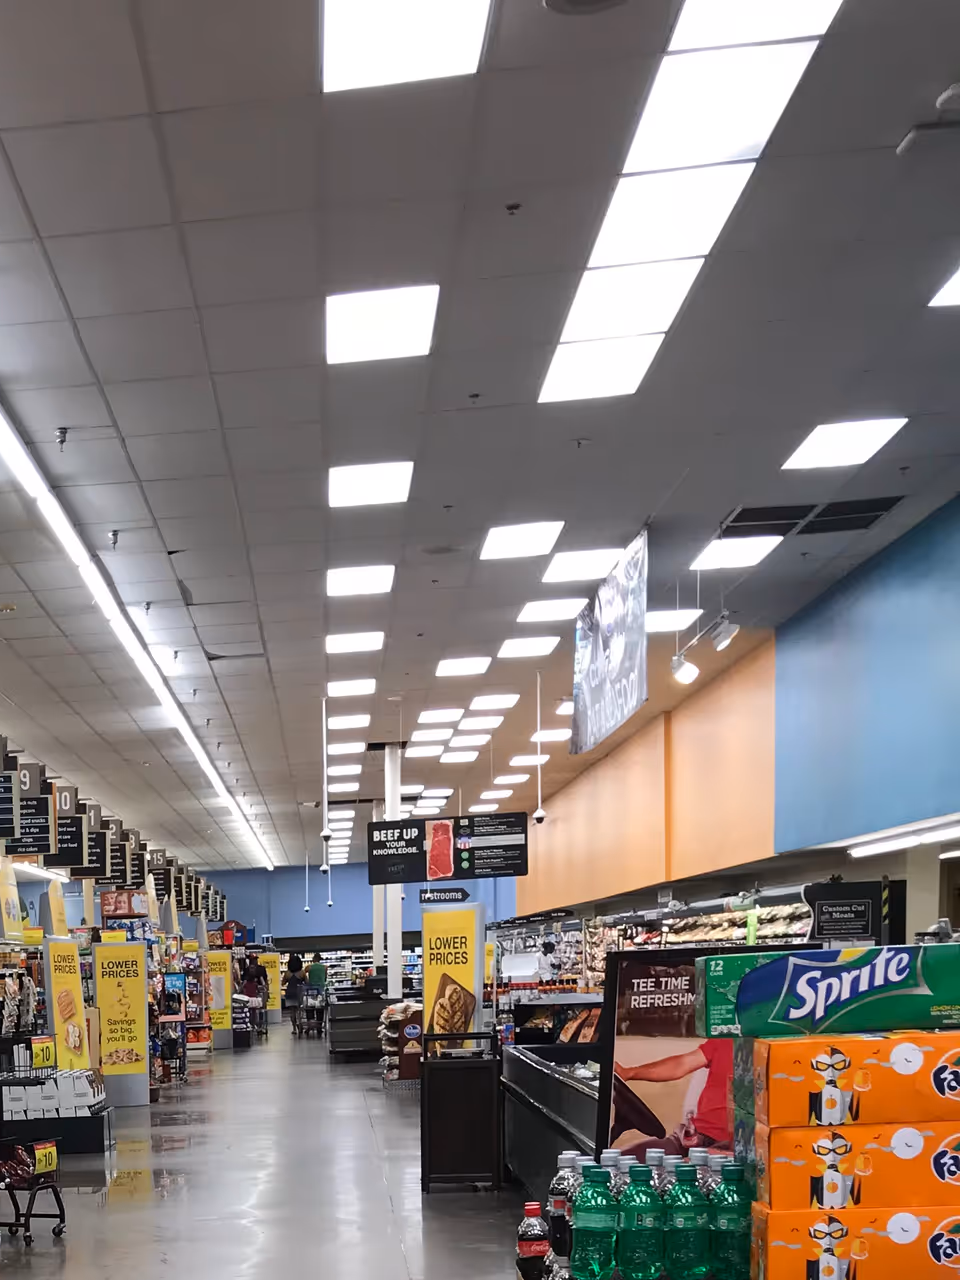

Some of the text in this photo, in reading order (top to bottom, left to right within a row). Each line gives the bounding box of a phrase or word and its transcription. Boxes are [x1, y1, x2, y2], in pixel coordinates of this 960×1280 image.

[19, 769, 30, 791] 9
[56, 792, 71, 810] 10
[373, 828, 419, 842] BEEF UP
[373, 846, 419, 856] KNOWLEDGE.
[152, 852, 163, 865] 15
[429, 936, 468, 951] LOWER
[53, 954, 75, 964] LOWER
[101, 960, 138, 970] LOWER
[429, 951, 468, 965] PRICES
[54, 964, 76, 975] PRICES
[710, 961, 724, 970] 12
[101, 969, 139, 979] PRICES
[632, 976, 690, 992] TEE TIME
[789, 946, 910, 1021] Sprite
[631, 992, 696, 1009] REFRESHM
[107, 1018, 137, 1027] Savings
[106, 1034, 138, 1044] you'll go
[41, 1046, 51, 1062] 10
[43, 1151, 53, 1167] 10
